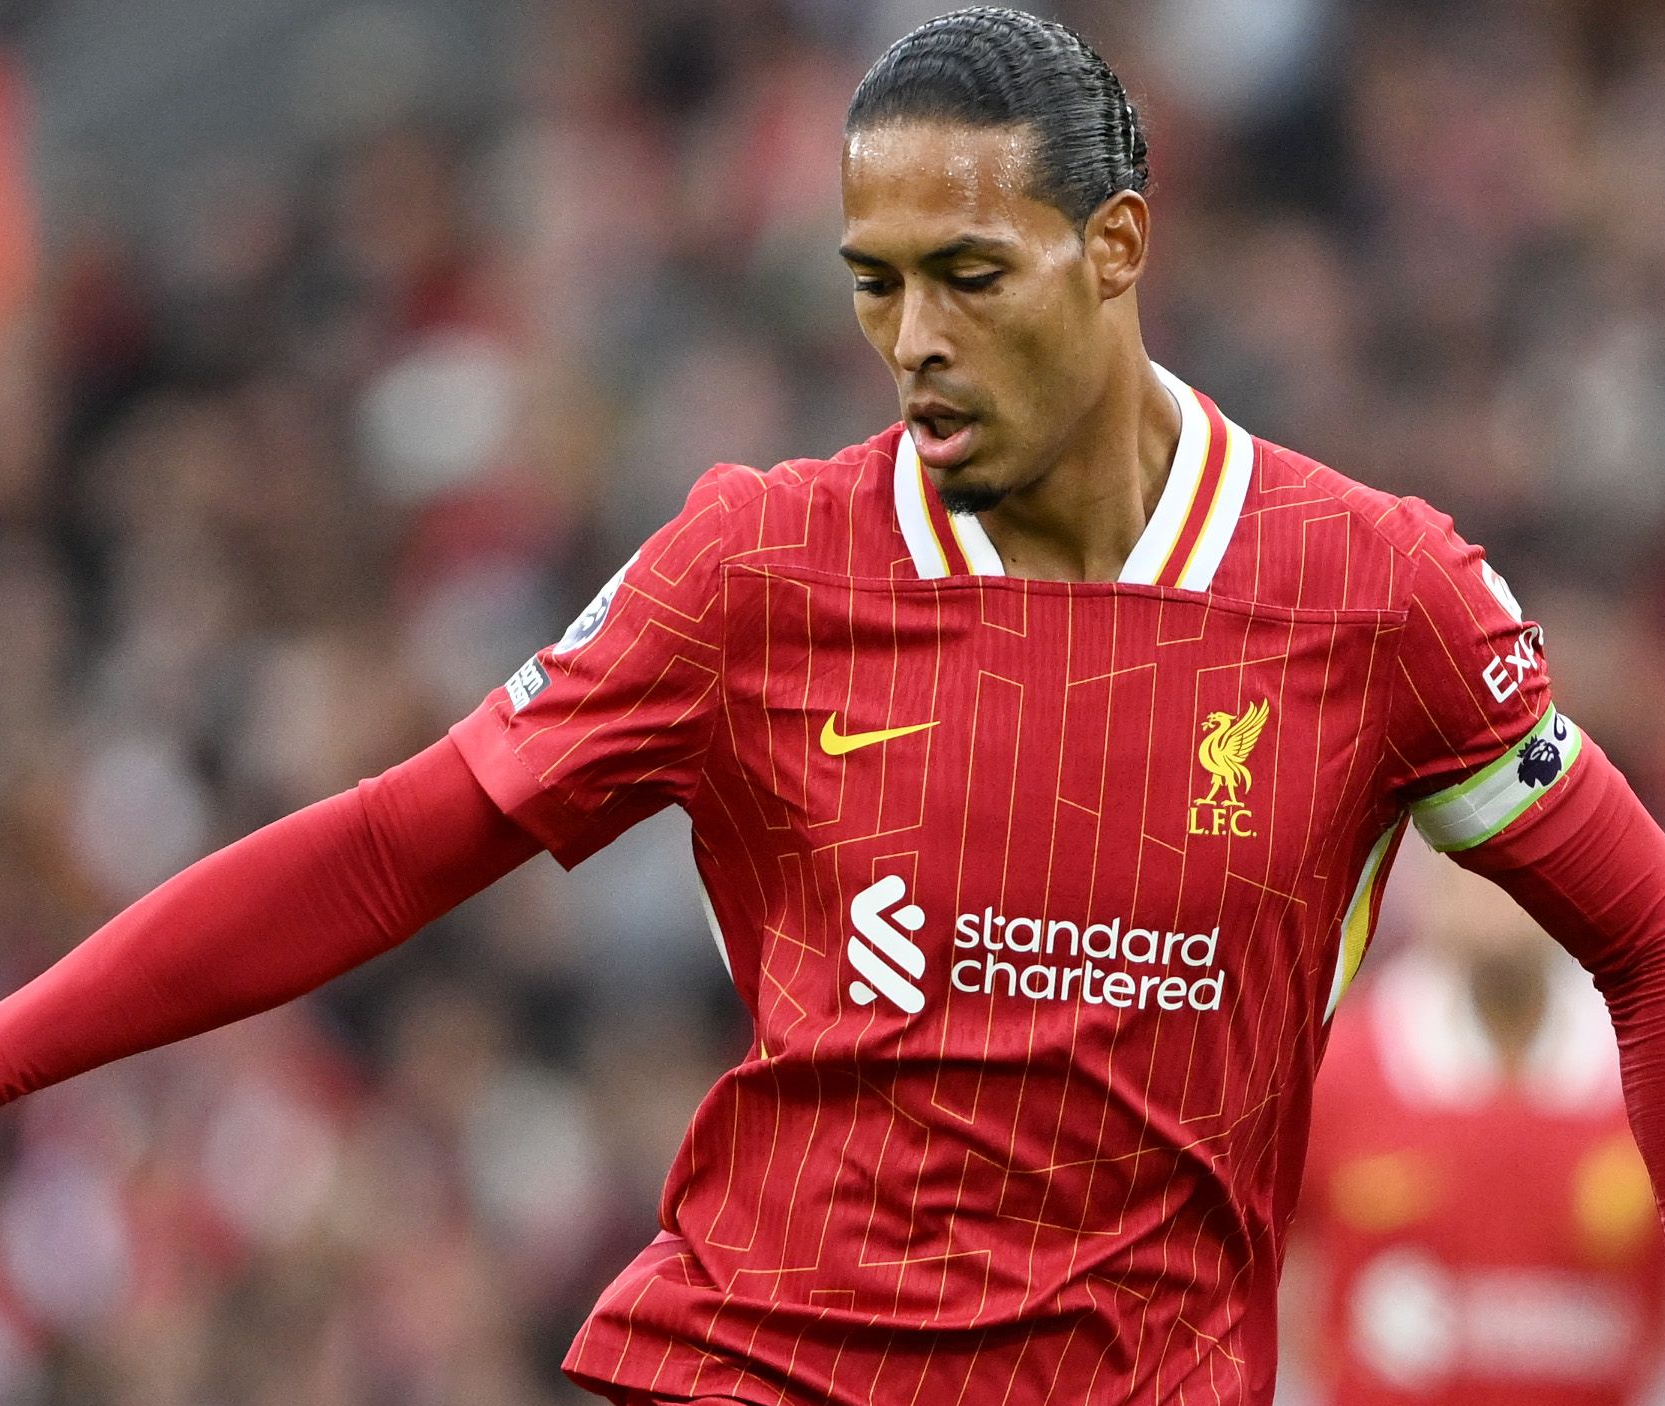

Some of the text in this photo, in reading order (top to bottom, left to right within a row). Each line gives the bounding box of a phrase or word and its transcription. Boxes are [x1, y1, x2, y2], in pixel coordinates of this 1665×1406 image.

[1483, 621, 1544, 704] Exp
[1189, 807, 1257, 837] L.F.C.
[953, 905, 1220, 967] standard
[950, 952, 1226, 1001] chartered
